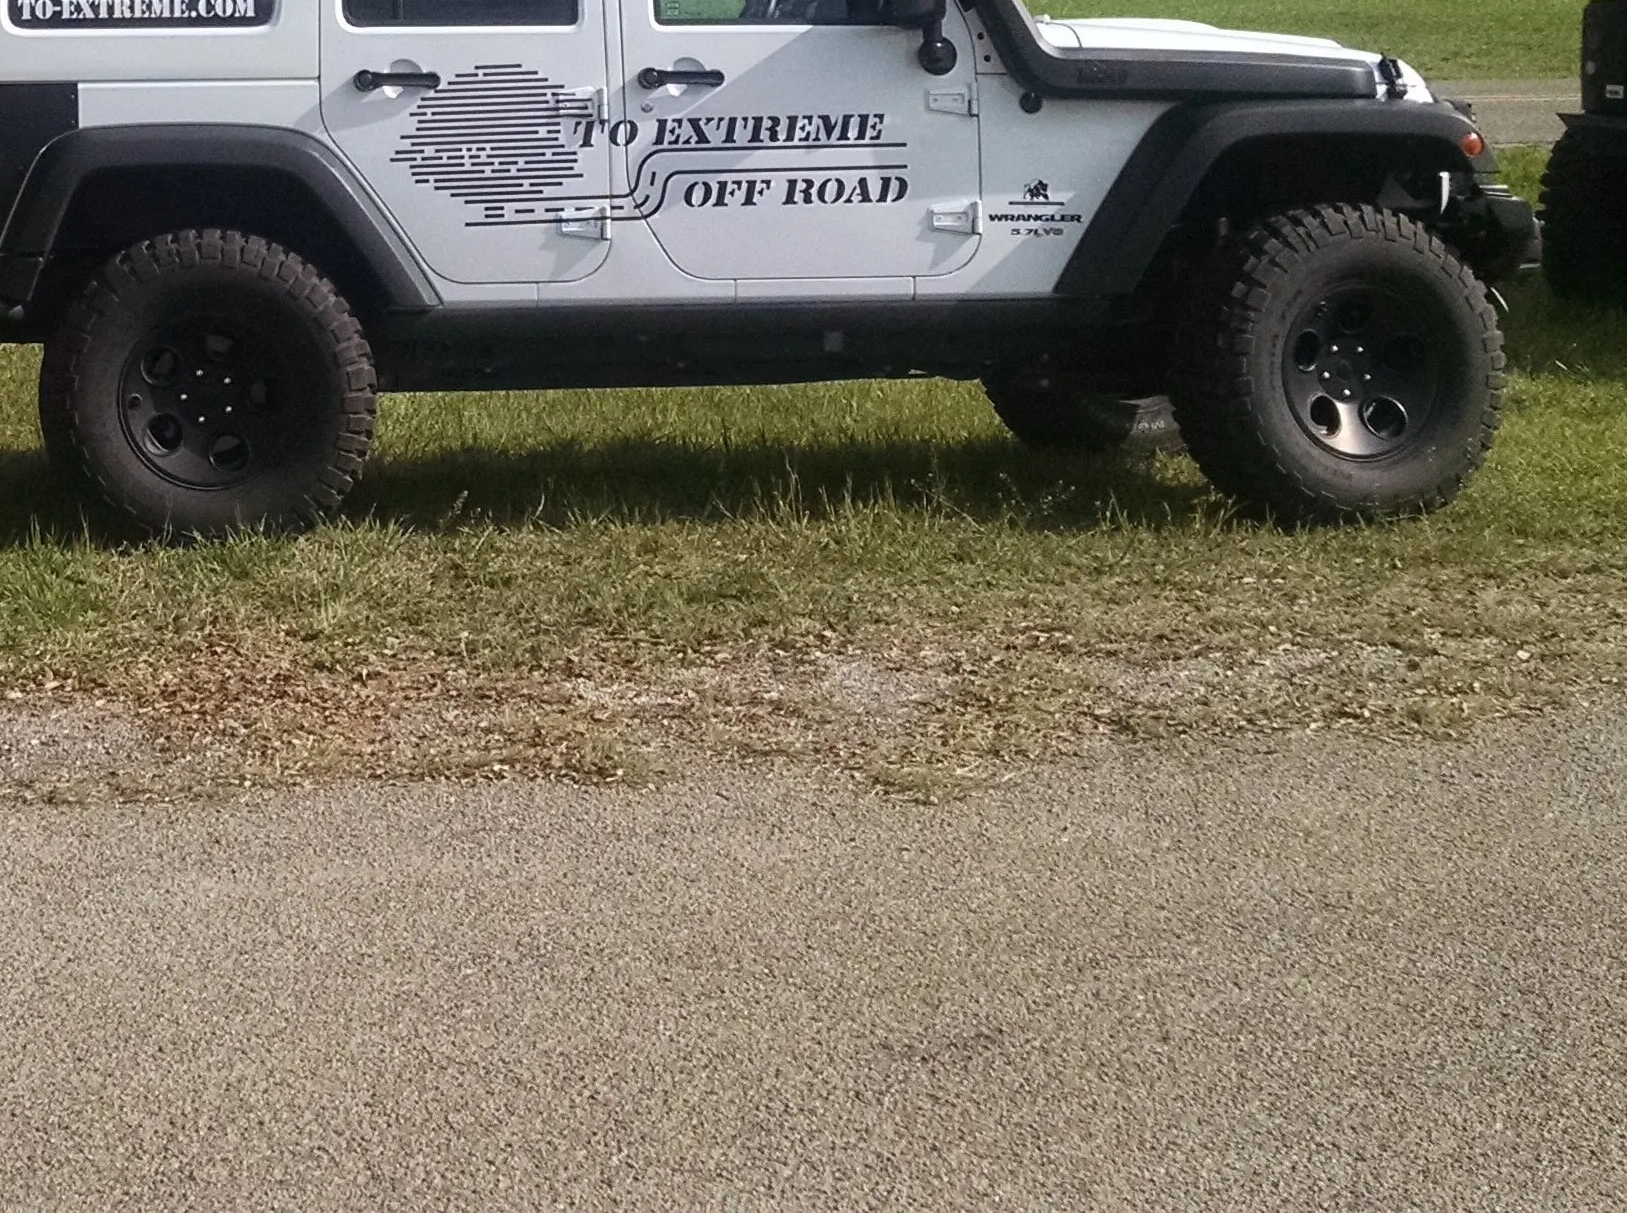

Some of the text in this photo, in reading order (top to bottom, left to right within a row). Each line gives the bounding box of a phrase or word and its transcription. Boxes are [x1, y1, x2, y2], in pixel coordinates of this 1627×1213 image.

[572, 112, 885, 149] TO EXTREME
[682, 175, 909, 209] OFF ROAD
[987, 213, 1083, 224] WRANGLER
